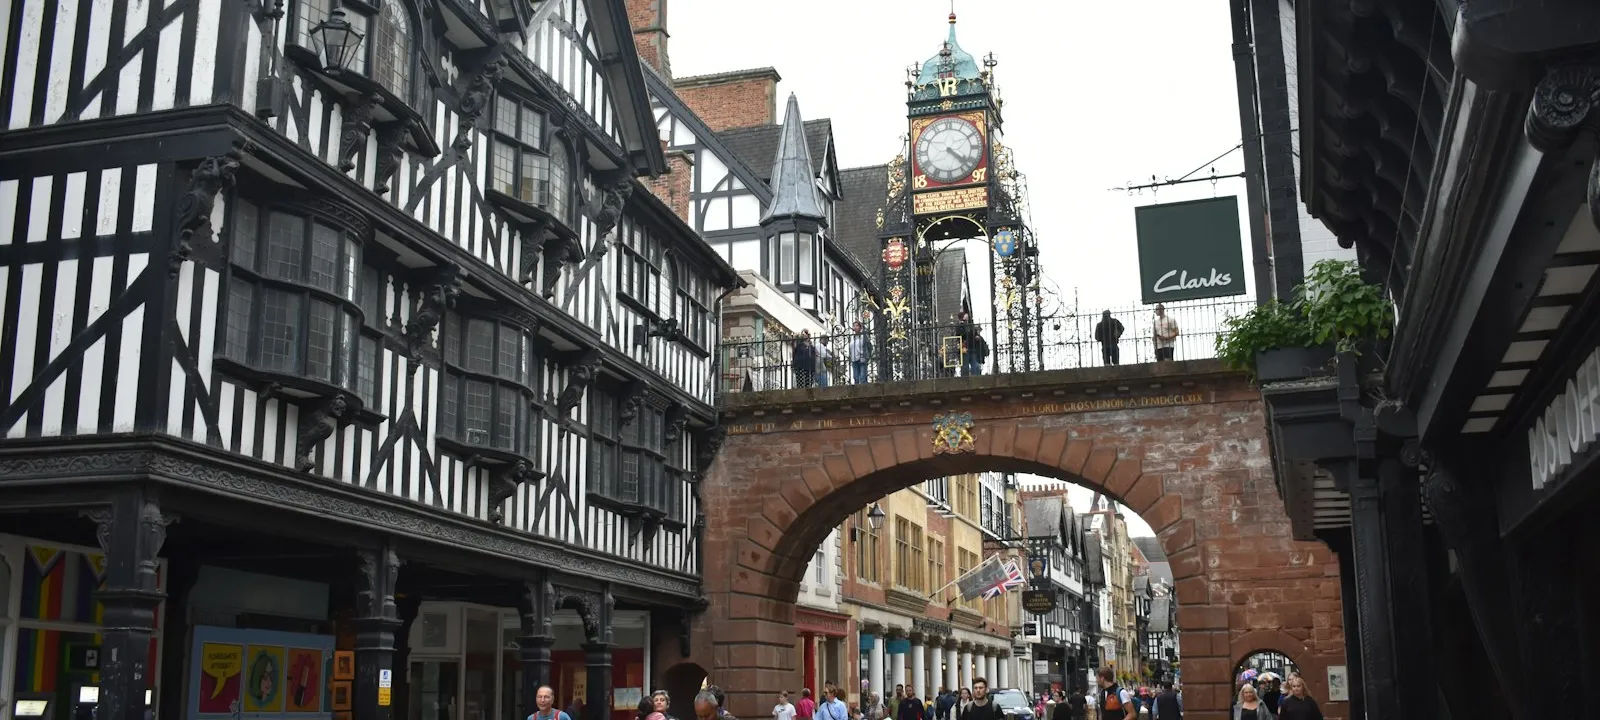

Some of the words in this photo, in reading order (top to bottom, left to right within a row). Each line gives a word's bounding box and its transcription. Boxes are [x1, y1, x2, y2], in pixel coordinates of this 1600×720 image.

[937, 77, 957, 97] VR
[914, 175, 927, 188] 18
[972, 167, 987, 182] 97
[1153, 267, 1232, 293] Clarks
[1063, 398, 1124, 412] GROSVENOR
[815, 419, 833, 428] THE
